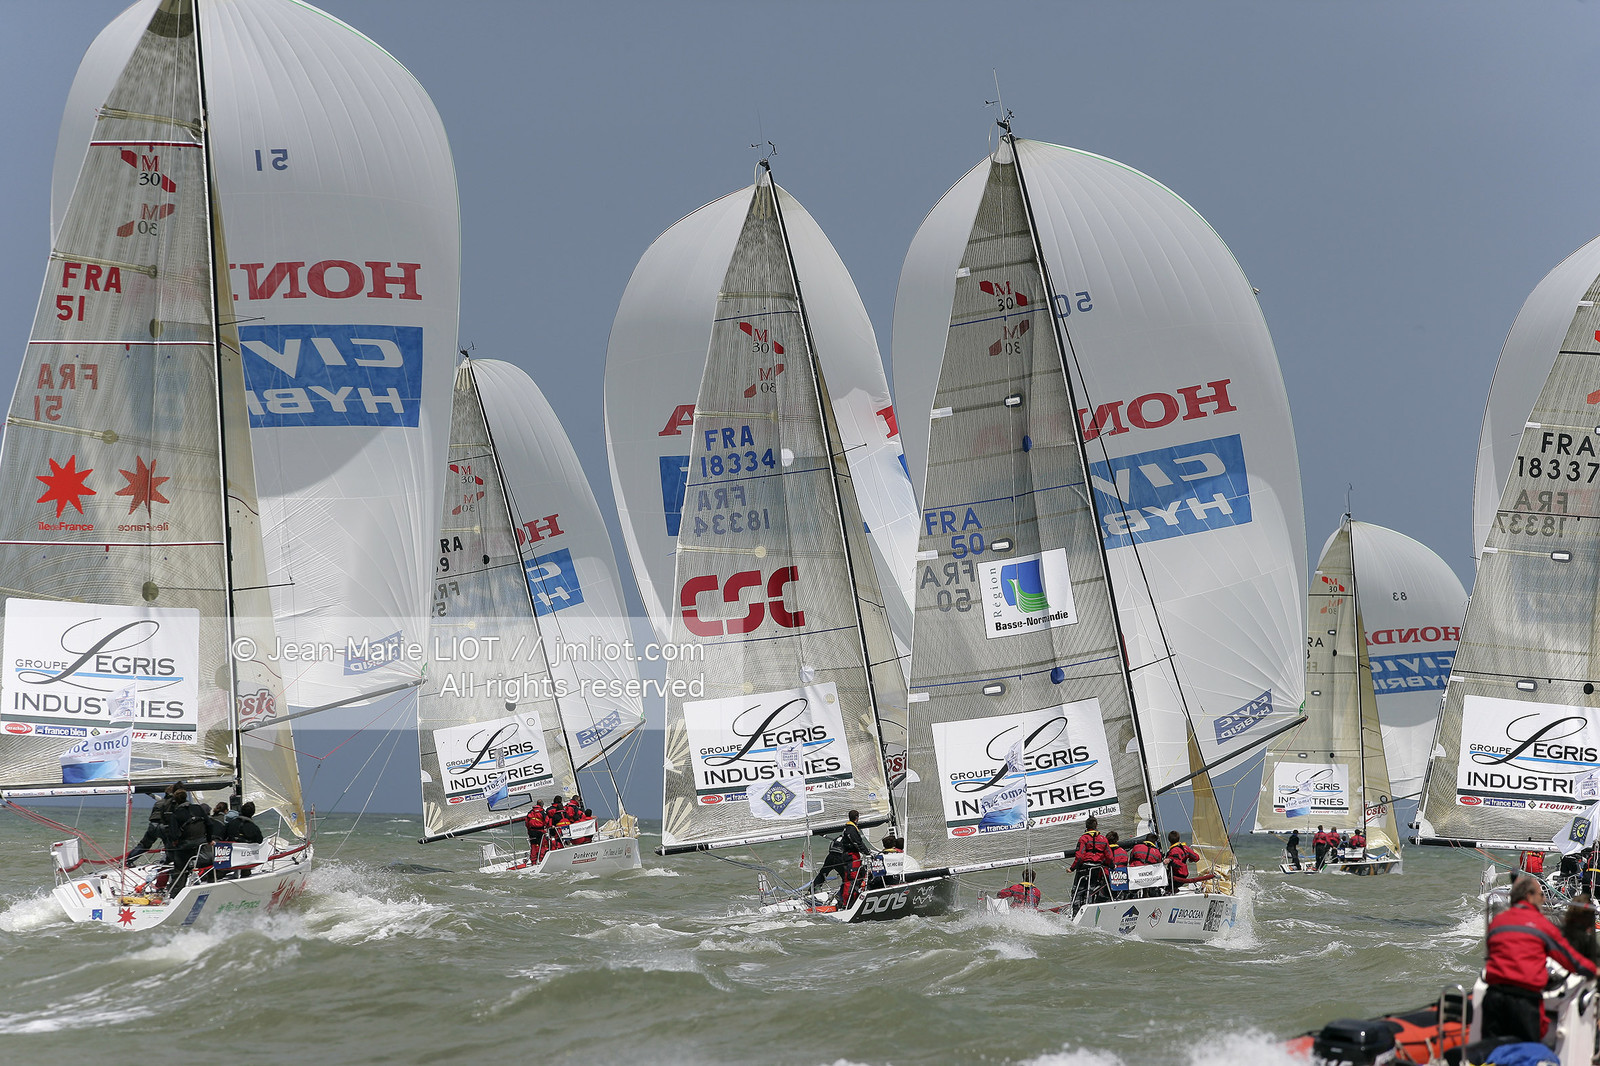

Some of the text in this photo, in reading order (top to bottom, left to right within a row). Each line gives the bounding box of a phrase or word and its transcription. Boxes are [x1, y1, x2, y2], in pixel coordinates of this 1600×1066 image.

[142, 155, 160, 172] M
[139, 173, 160, 186] 30
[62, 262, 122, 293] FRA
[56, 295, 85, 321] 51
[998, 297, 1014, 312] 30
[752, 342, 770, 354] 30
[705, 426, 754, 451] FRA
[1541, 432, 1596, 457] FRA
[701, 448, 776, 478] 18334
[1518, 456, 1600, 483] 18337
[461, 476, 474, 484] 30
[925, 507, 982, 535] FRA
[440, 536, 463, 553] RA
[951, 533, 984, 559] 50
[681, 566, 805, 637] CSC
[989, 567, 1002, 618] Région
[995, 610, 1069, 631] Basse-Normandie
[1308, 637, 1324, 647] RA
[15, 659, 68, 671] GROUPE
[14, 692, 185, 719] INDUSIES
[45, 727, 86, 737] france bleu
[700, 744, 743, 755] GROUPE
[1470, 743, 1512, 754] GROUPE
[446, 758, 474, 767] GROUPE
[704, 757, 841, 785] INDUSIES
[950, 768, 997, 780] GROUPE
[1467, 771, 1573, 794] INDUSTRI
[733, 793, 749, 801] franc
[955, 781, 1105, 816] INTRIES
[1278, 796, 1344, 806] INTRIES
[1512, 800, 1525, 808] bleu
[861, 891, 908, 915] DCNS
